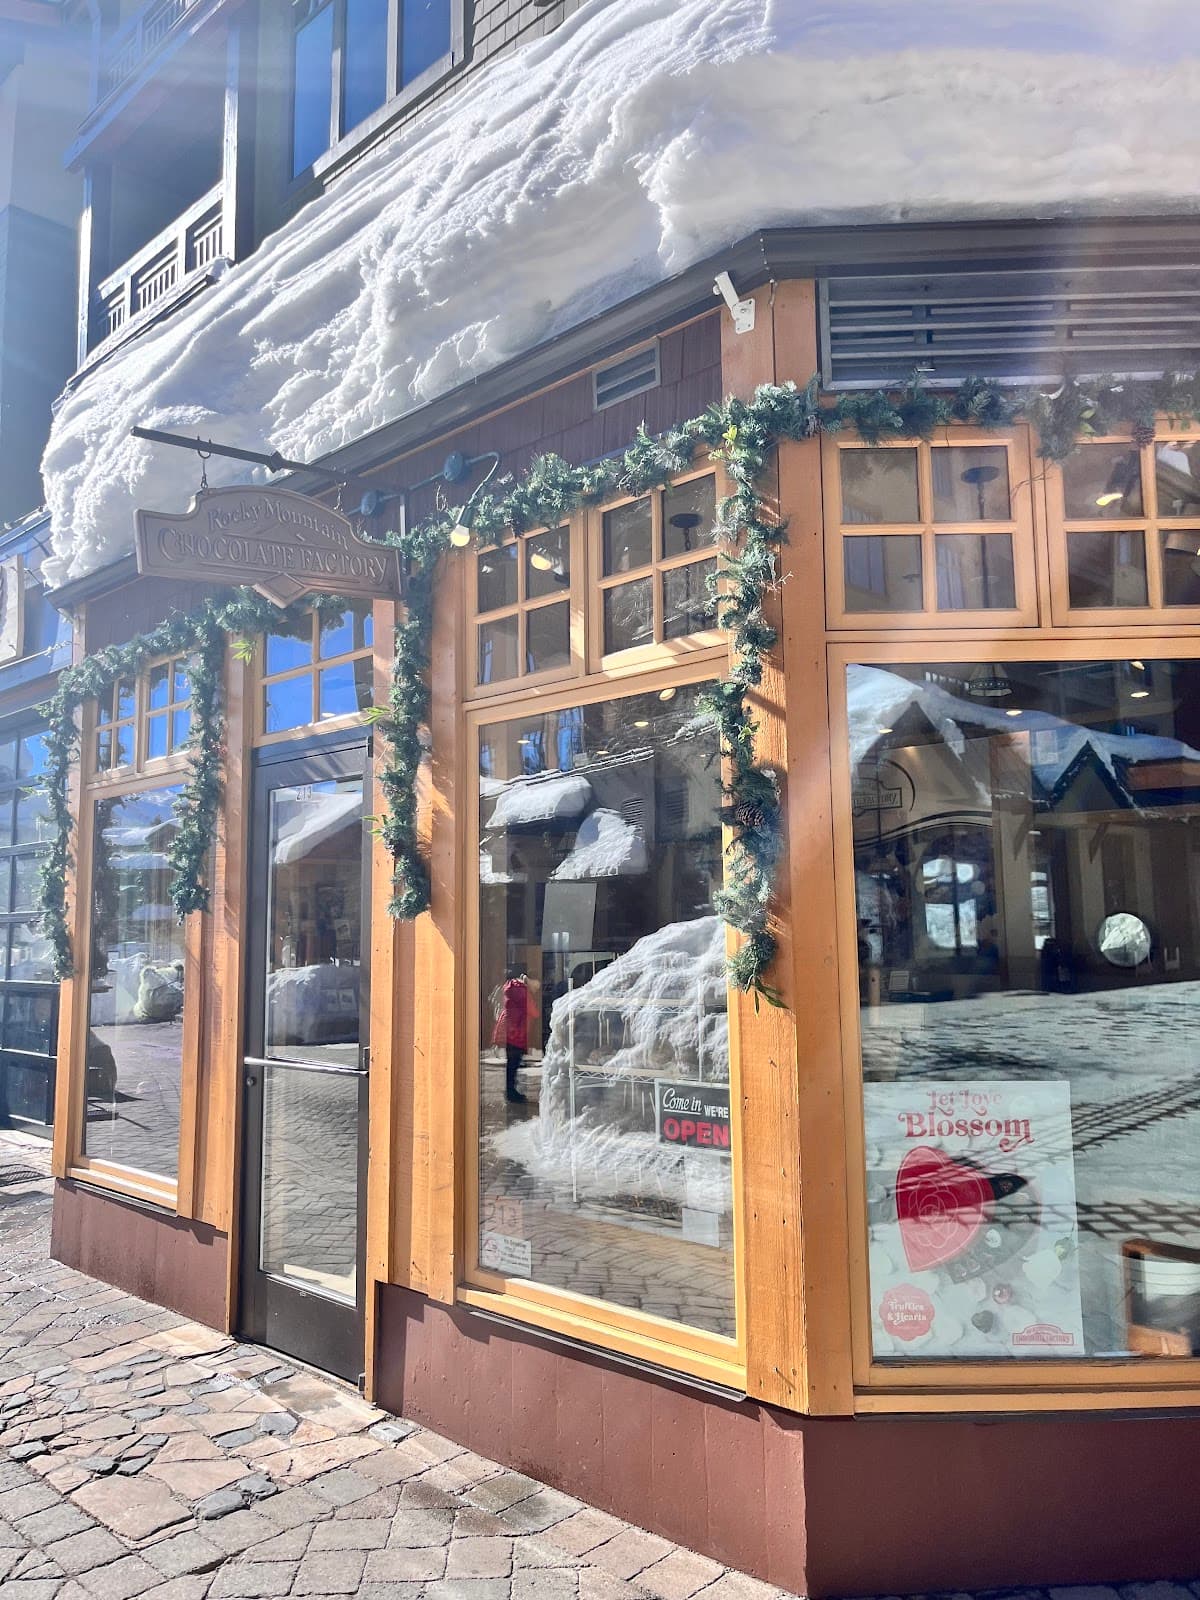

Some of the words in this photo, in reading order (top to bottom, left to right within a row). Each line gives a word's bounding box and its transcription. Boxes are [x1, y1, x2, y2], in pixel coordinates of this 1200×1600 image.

[207, 500, 264, 531] Rocky
[264, 499, 349, 550] Mountain
[157, 528, 296, 570] CHOCOLATE
[301, 549, 388, 584] FACTORY
[662, 1087, 689, 1111] Come
[690, 1096, 702, 1112] in
[704, 1104, 729, 1118] WE'RE
[663, 1117, 729, 1148] OPEN
[898, 1111, 1035, 1152] Blossom
